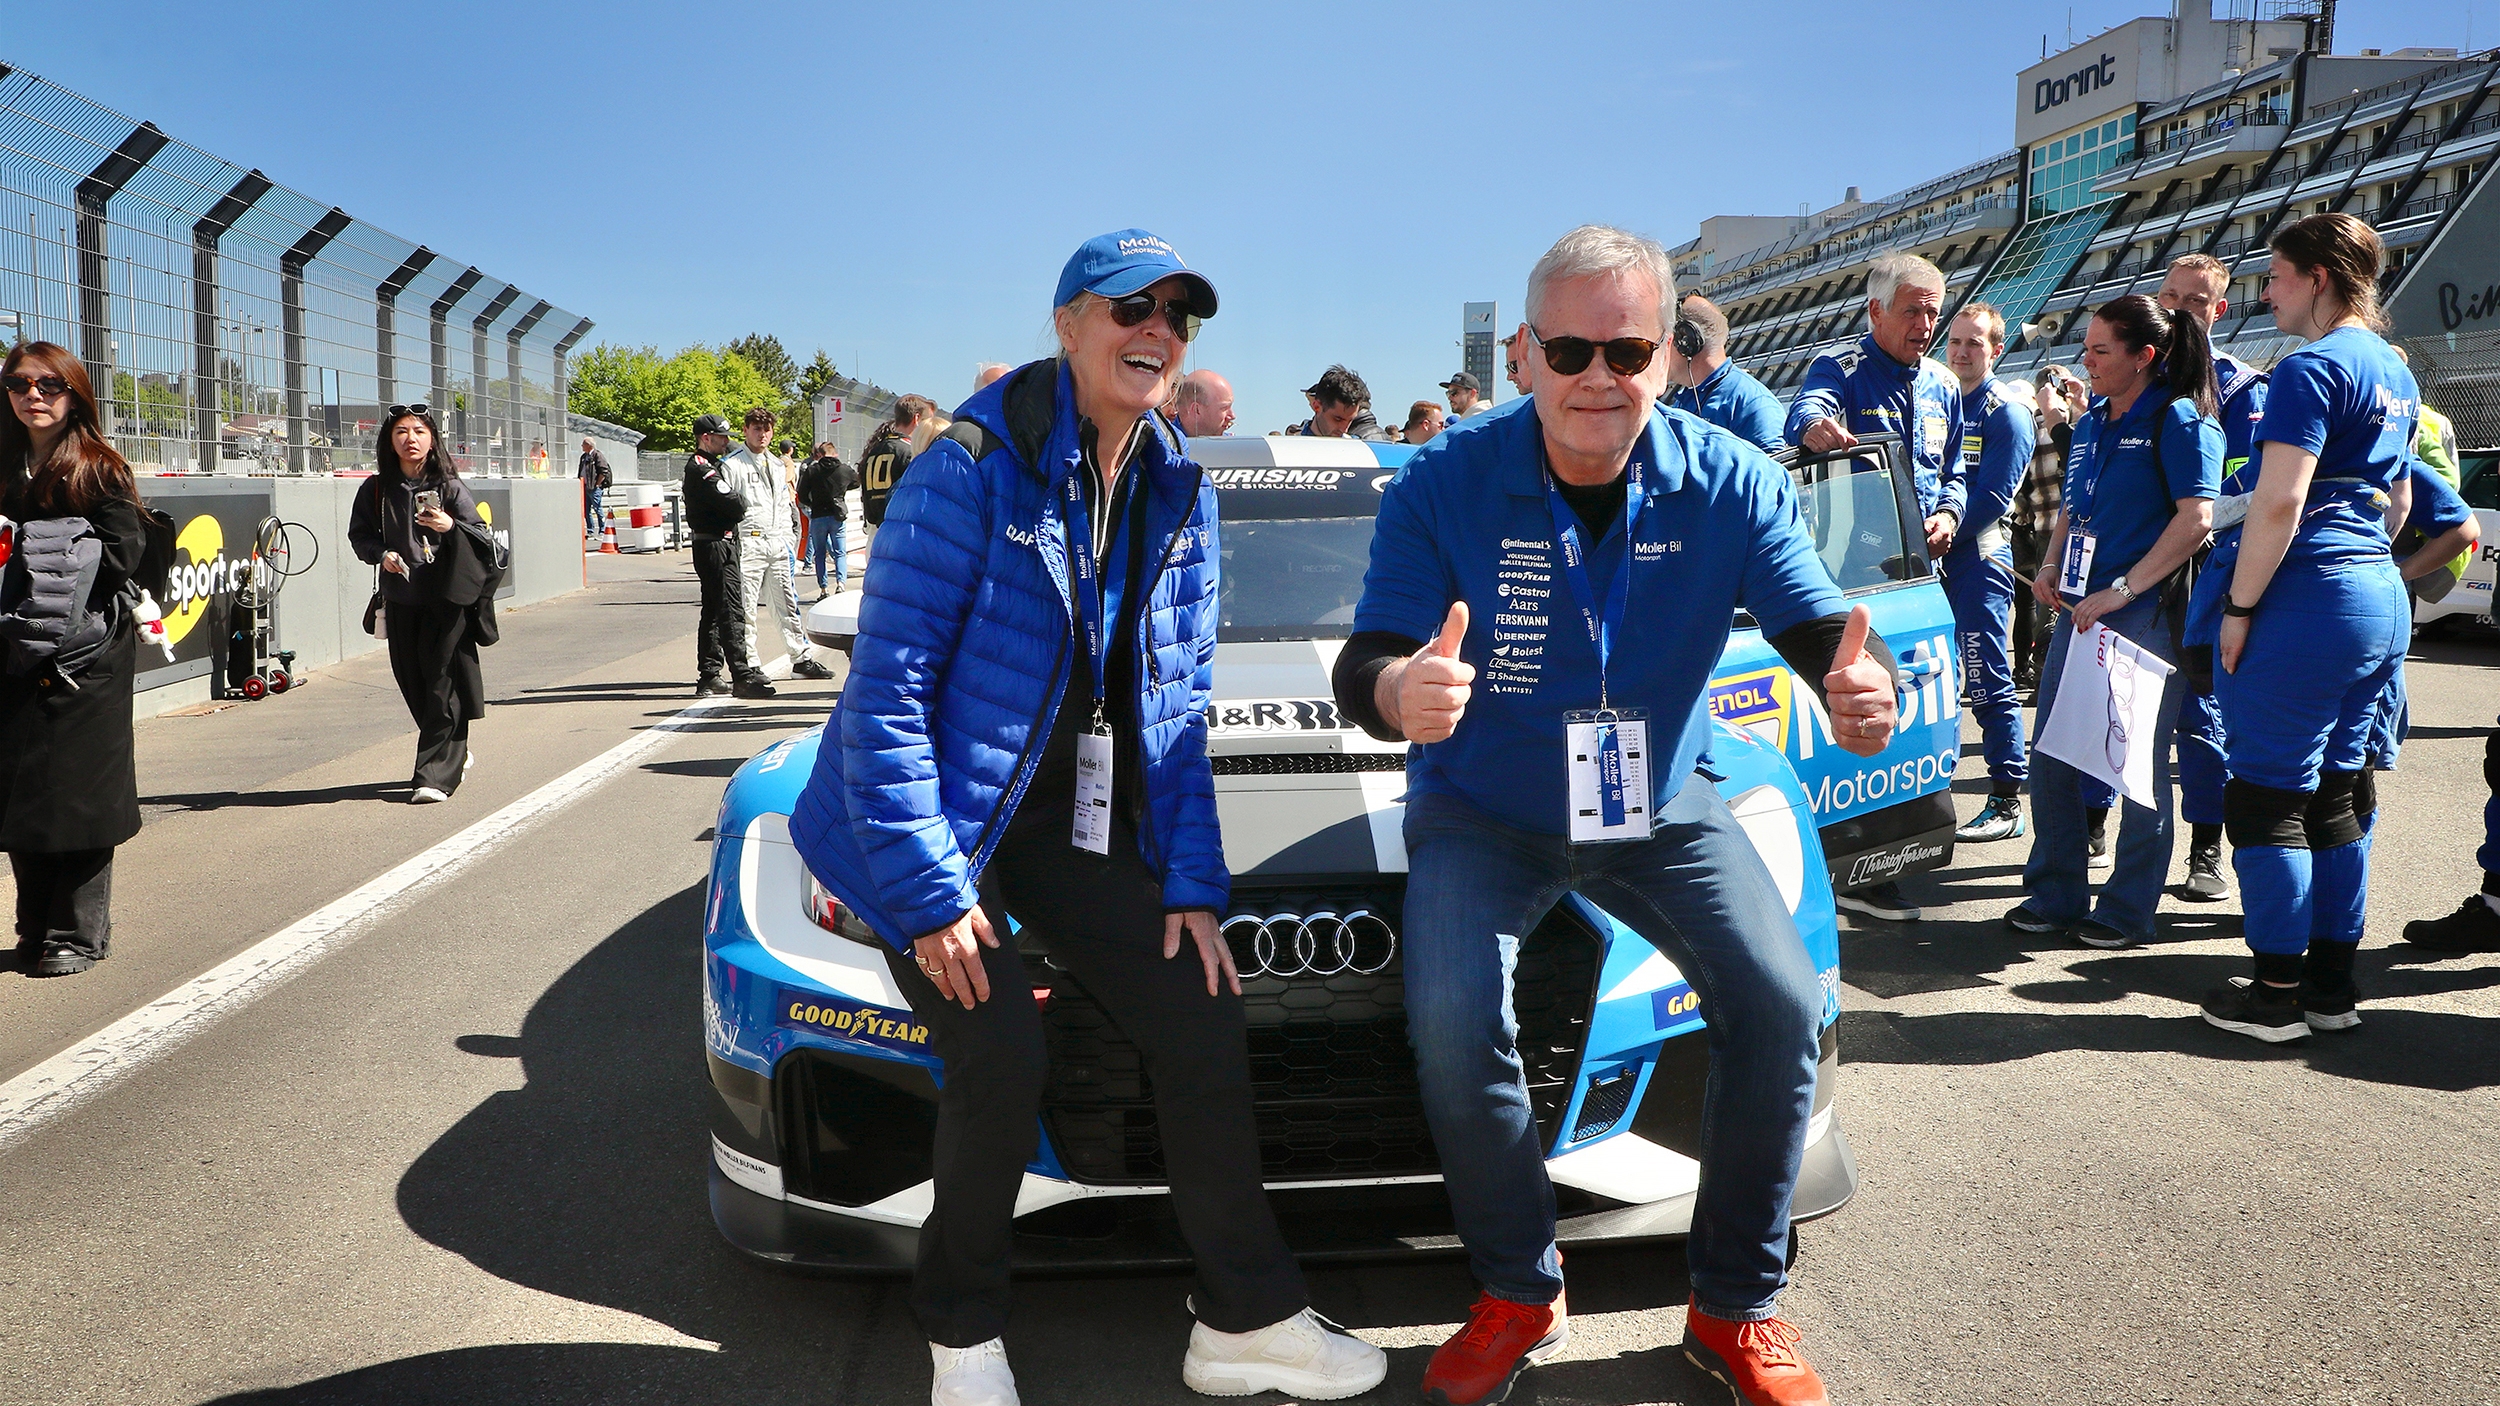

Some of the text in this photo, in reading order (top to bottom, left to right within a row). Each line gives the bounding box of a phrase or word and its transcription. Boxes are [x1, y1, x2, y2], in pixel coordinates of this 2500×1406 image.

[2034, 53, 2116, 115] Dorint
[1122, 248, 1167, 257] Motorsport
[866, 453, 895, 491] 10
[747, 472, 760, 484] 10
[1241, 483, 1338, 491] SIMULATOR
[1501, 538, 1544, 549] Continental
[1669, 540, 1682, 552] Bil
[1506, 553, 1546, 561] VOLKSWAGEN
[1302, 564, 1341, 573] RECARO
[1521, 560, 1552, 569] BILFINANS
[1498, 571, 1552, 582] GOODYEAR
[1511, 585, 1551, 598] Castrol
[1509, 598, 1539, 612] Aars
[1495, 613, 1549, 626] FERSKVANN
[1503, 632, 1547, 641] BERNER
[1511, 646, 1544, 657] Bolest
[1497, 672, 1539, 683] Sharebox
[1501, 686, 1533, 695] ARTISTI
[1971, 688, 1988, 706] Bil
[789, 1001, 929, 1045] GOODYEAR
